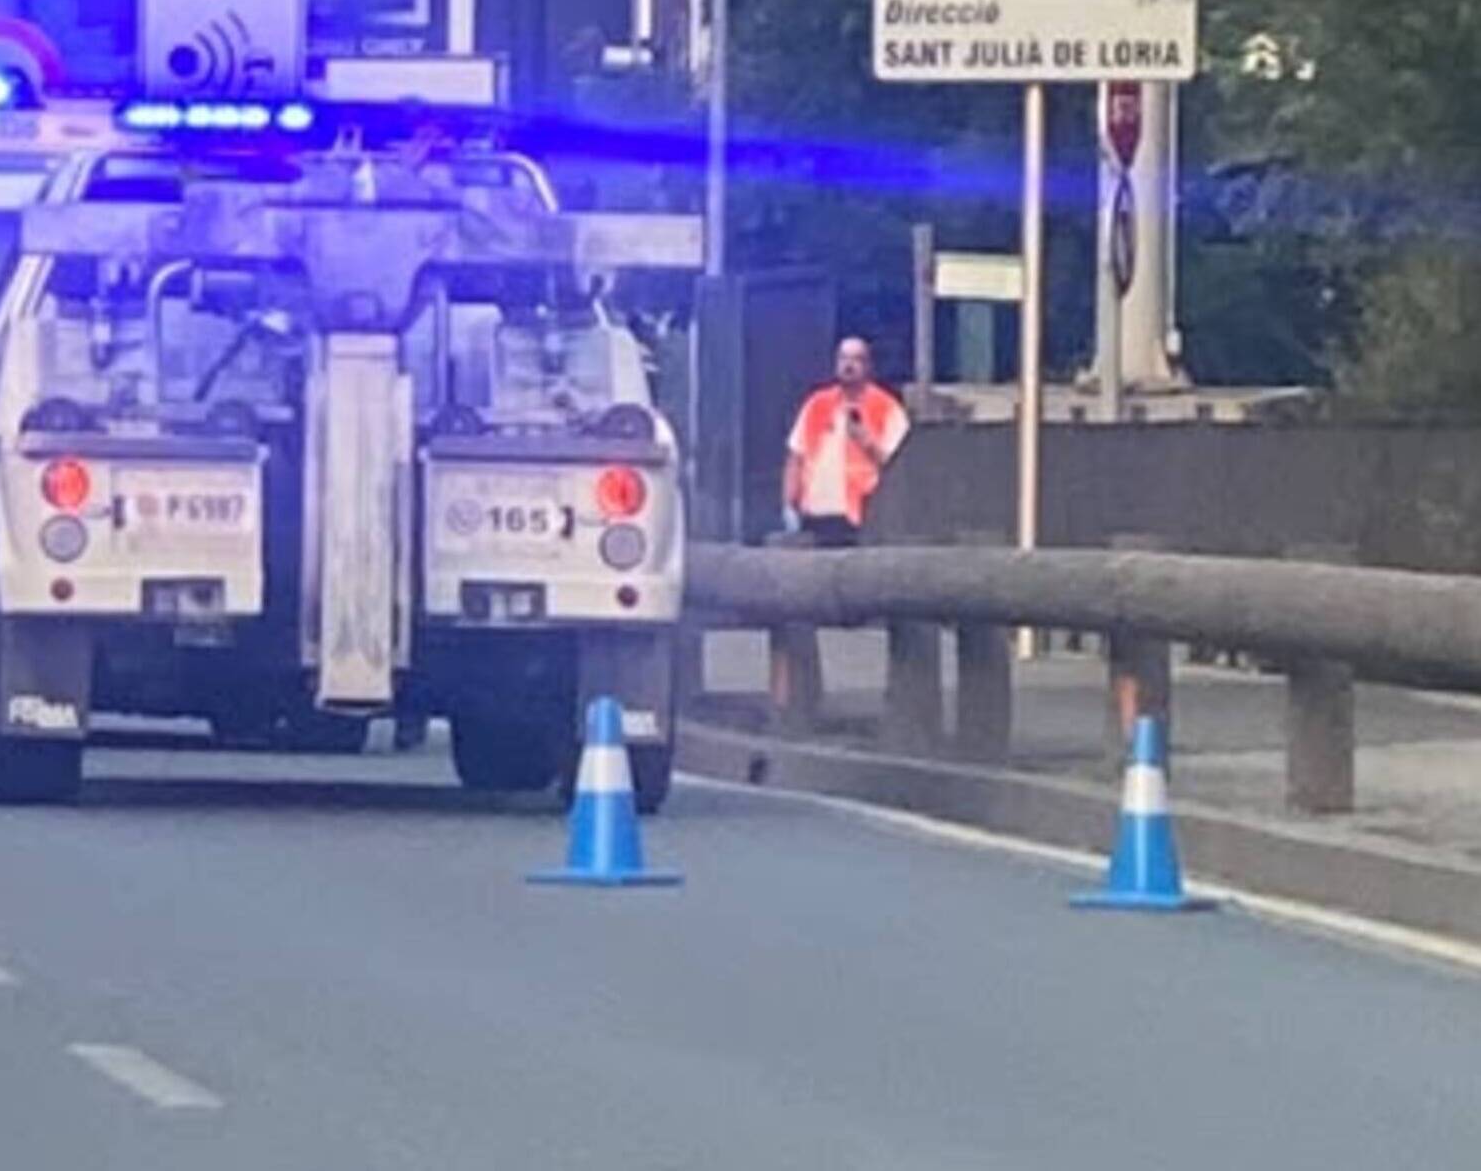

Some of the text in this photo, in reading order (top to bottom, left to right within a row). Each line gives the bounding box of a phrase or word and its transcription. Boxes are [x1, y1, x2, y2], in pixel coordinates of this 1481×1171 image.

[883, 38, 954, 68] SANT
[1053, 39, 1087, 68] DE
[488, 506, 549, 533] 165
